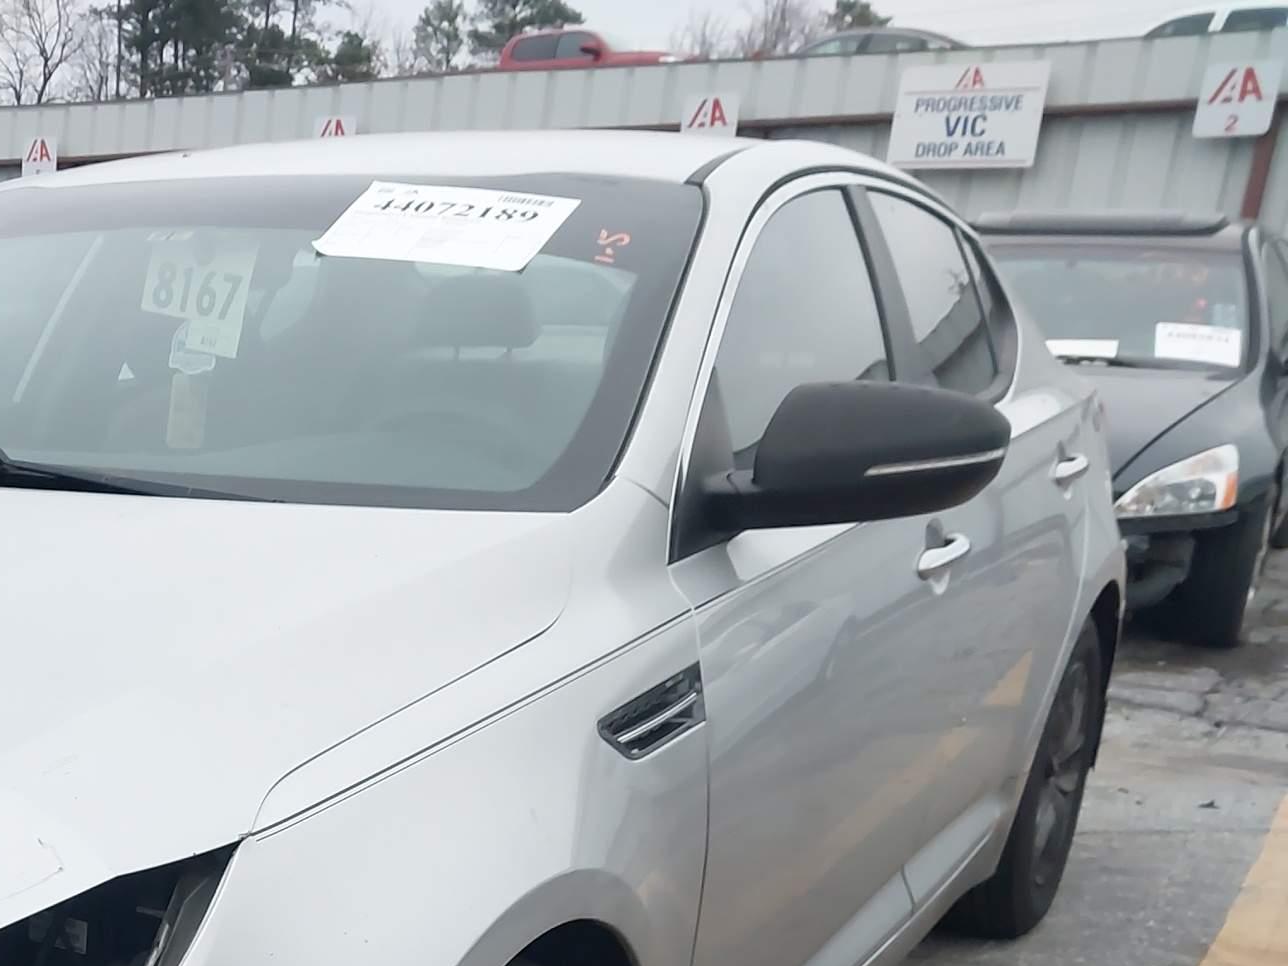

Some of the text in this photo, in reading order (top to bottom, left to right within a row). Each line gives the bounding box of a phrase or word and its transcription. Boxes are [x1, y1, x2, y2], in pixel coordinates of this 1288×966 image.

[914, 95, 1024, 113] PROGRESSIVE
[944, 114, 987, 137] VIC
[1224, 113, 1240, 133] 2
[914, 141, 1006, 158] DROP AREA
[373, 197, 539, 222] 44072189
[152, 260, 243, 321] 8167
